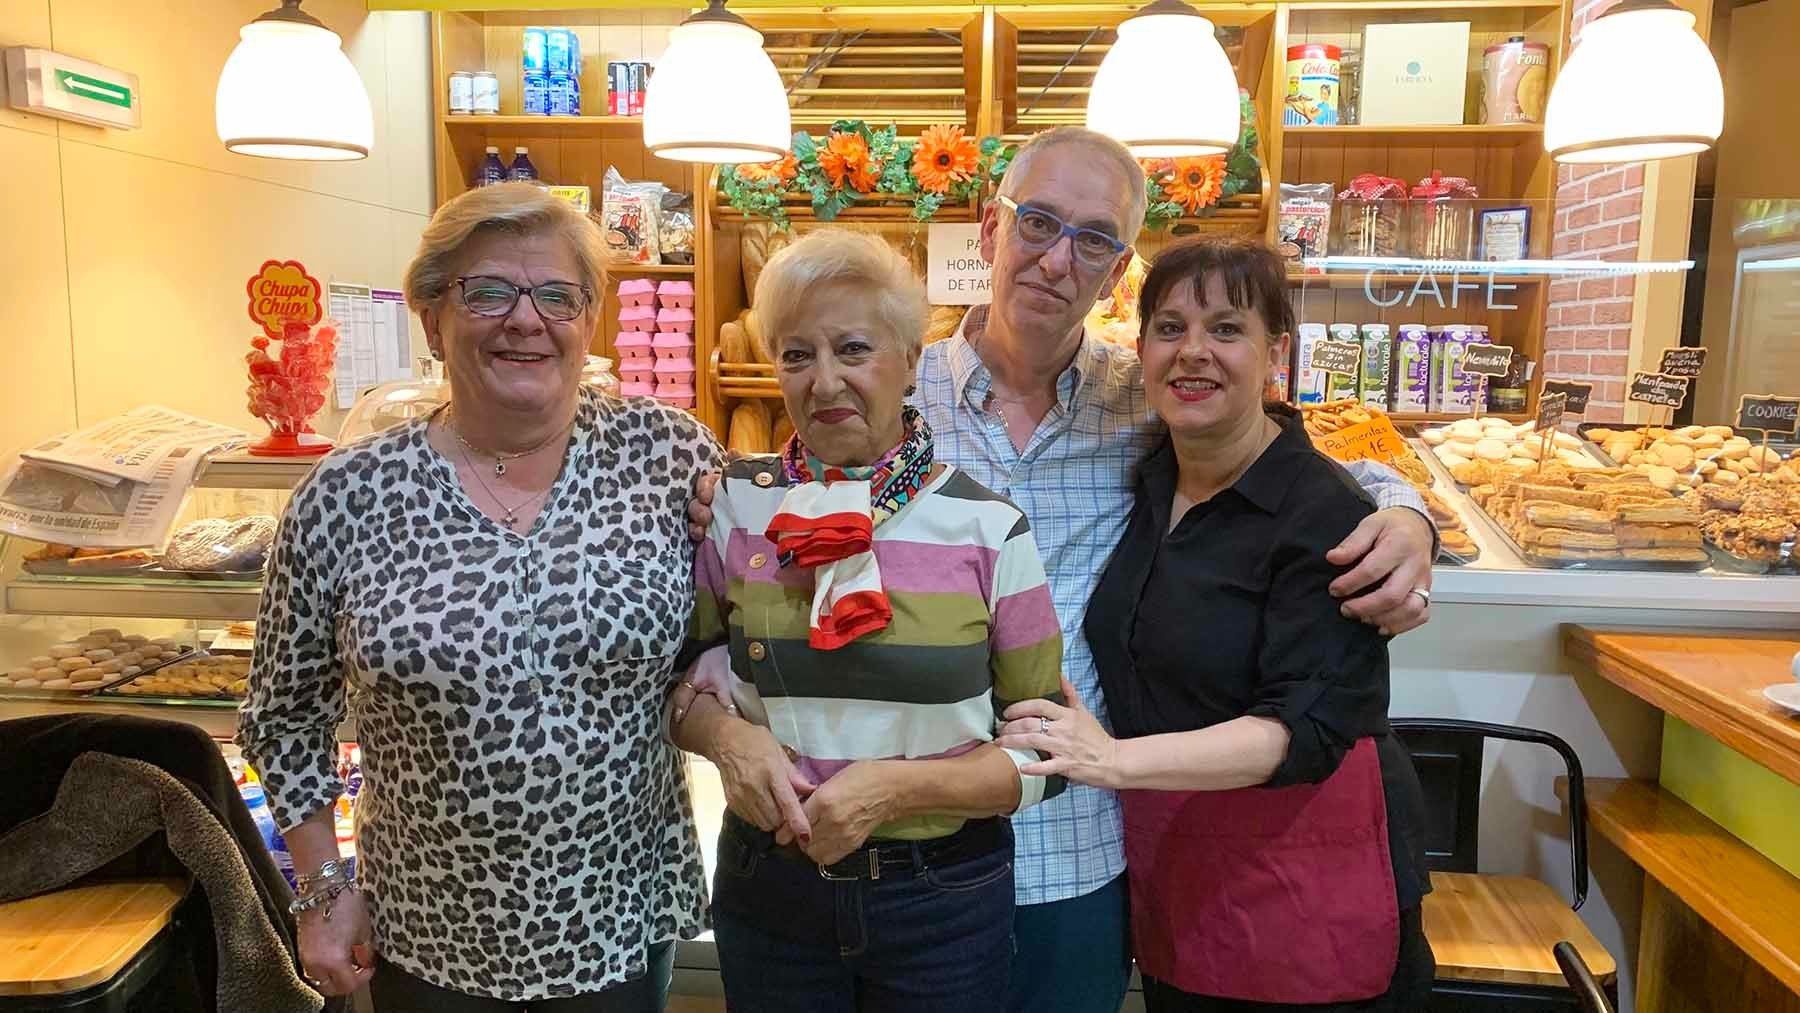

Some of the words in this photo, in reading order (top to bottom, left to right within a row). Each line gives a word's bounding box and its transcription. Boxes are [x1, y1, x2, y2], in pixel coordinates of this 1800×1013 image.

[260, 280, 310, 300] Chupa
[948, 279, 965, 291] DE
[1364, 267, 1518, 310] CAFE
